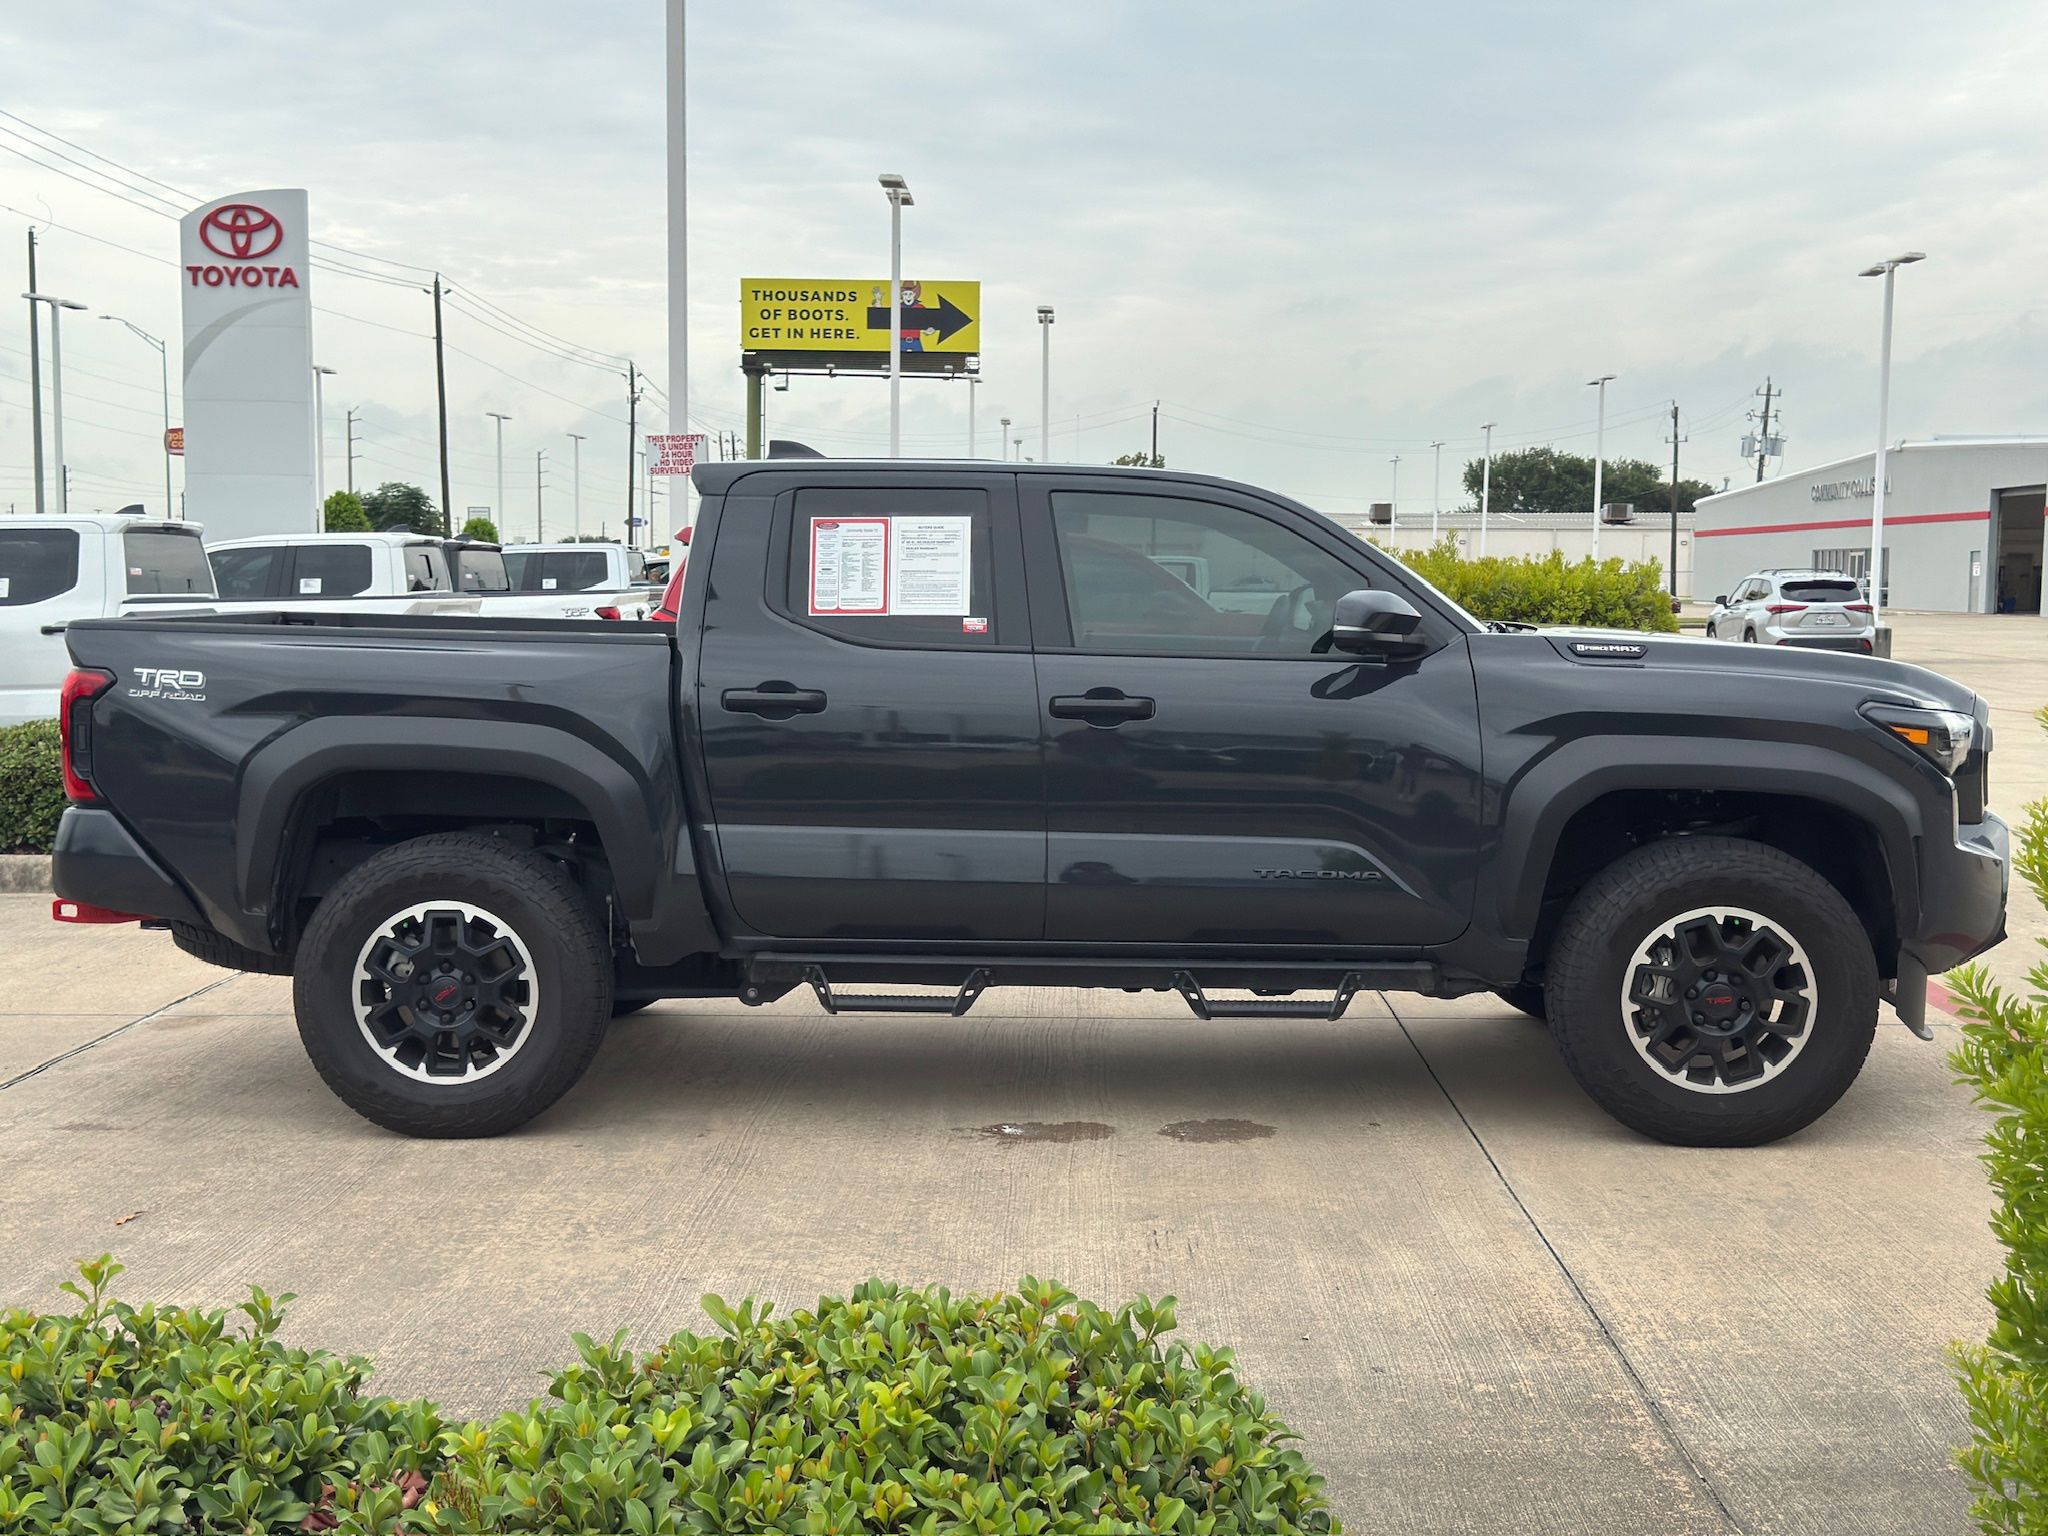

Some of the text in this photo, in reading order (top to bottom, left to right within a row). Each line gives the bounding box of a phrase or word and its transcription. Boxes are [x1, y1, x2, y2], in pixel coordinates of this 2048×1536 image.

[186, 266, 299, 288] TOYOTA
[752, 290, 857, 301] THOUSANDS
[760, 309, 849, 321] OF BOOTS.
[749, 327, 860, 340] GET IN HERE.
[646, 434, 705, 443] THIS PROPERTY
[659, 443, 694, 451] IS UNDER
[672, 458, 694, 466] VIDEO
[650, 467, 691, 475] SURVEILLA
[1811, 475, 1891, 502] COMMUNITY COLLISN
[133, 667, 206, 689] TRD
[128, 688, 206, 702] OFF ROAD
[1254, 868, 1382, 881] TACOMA
